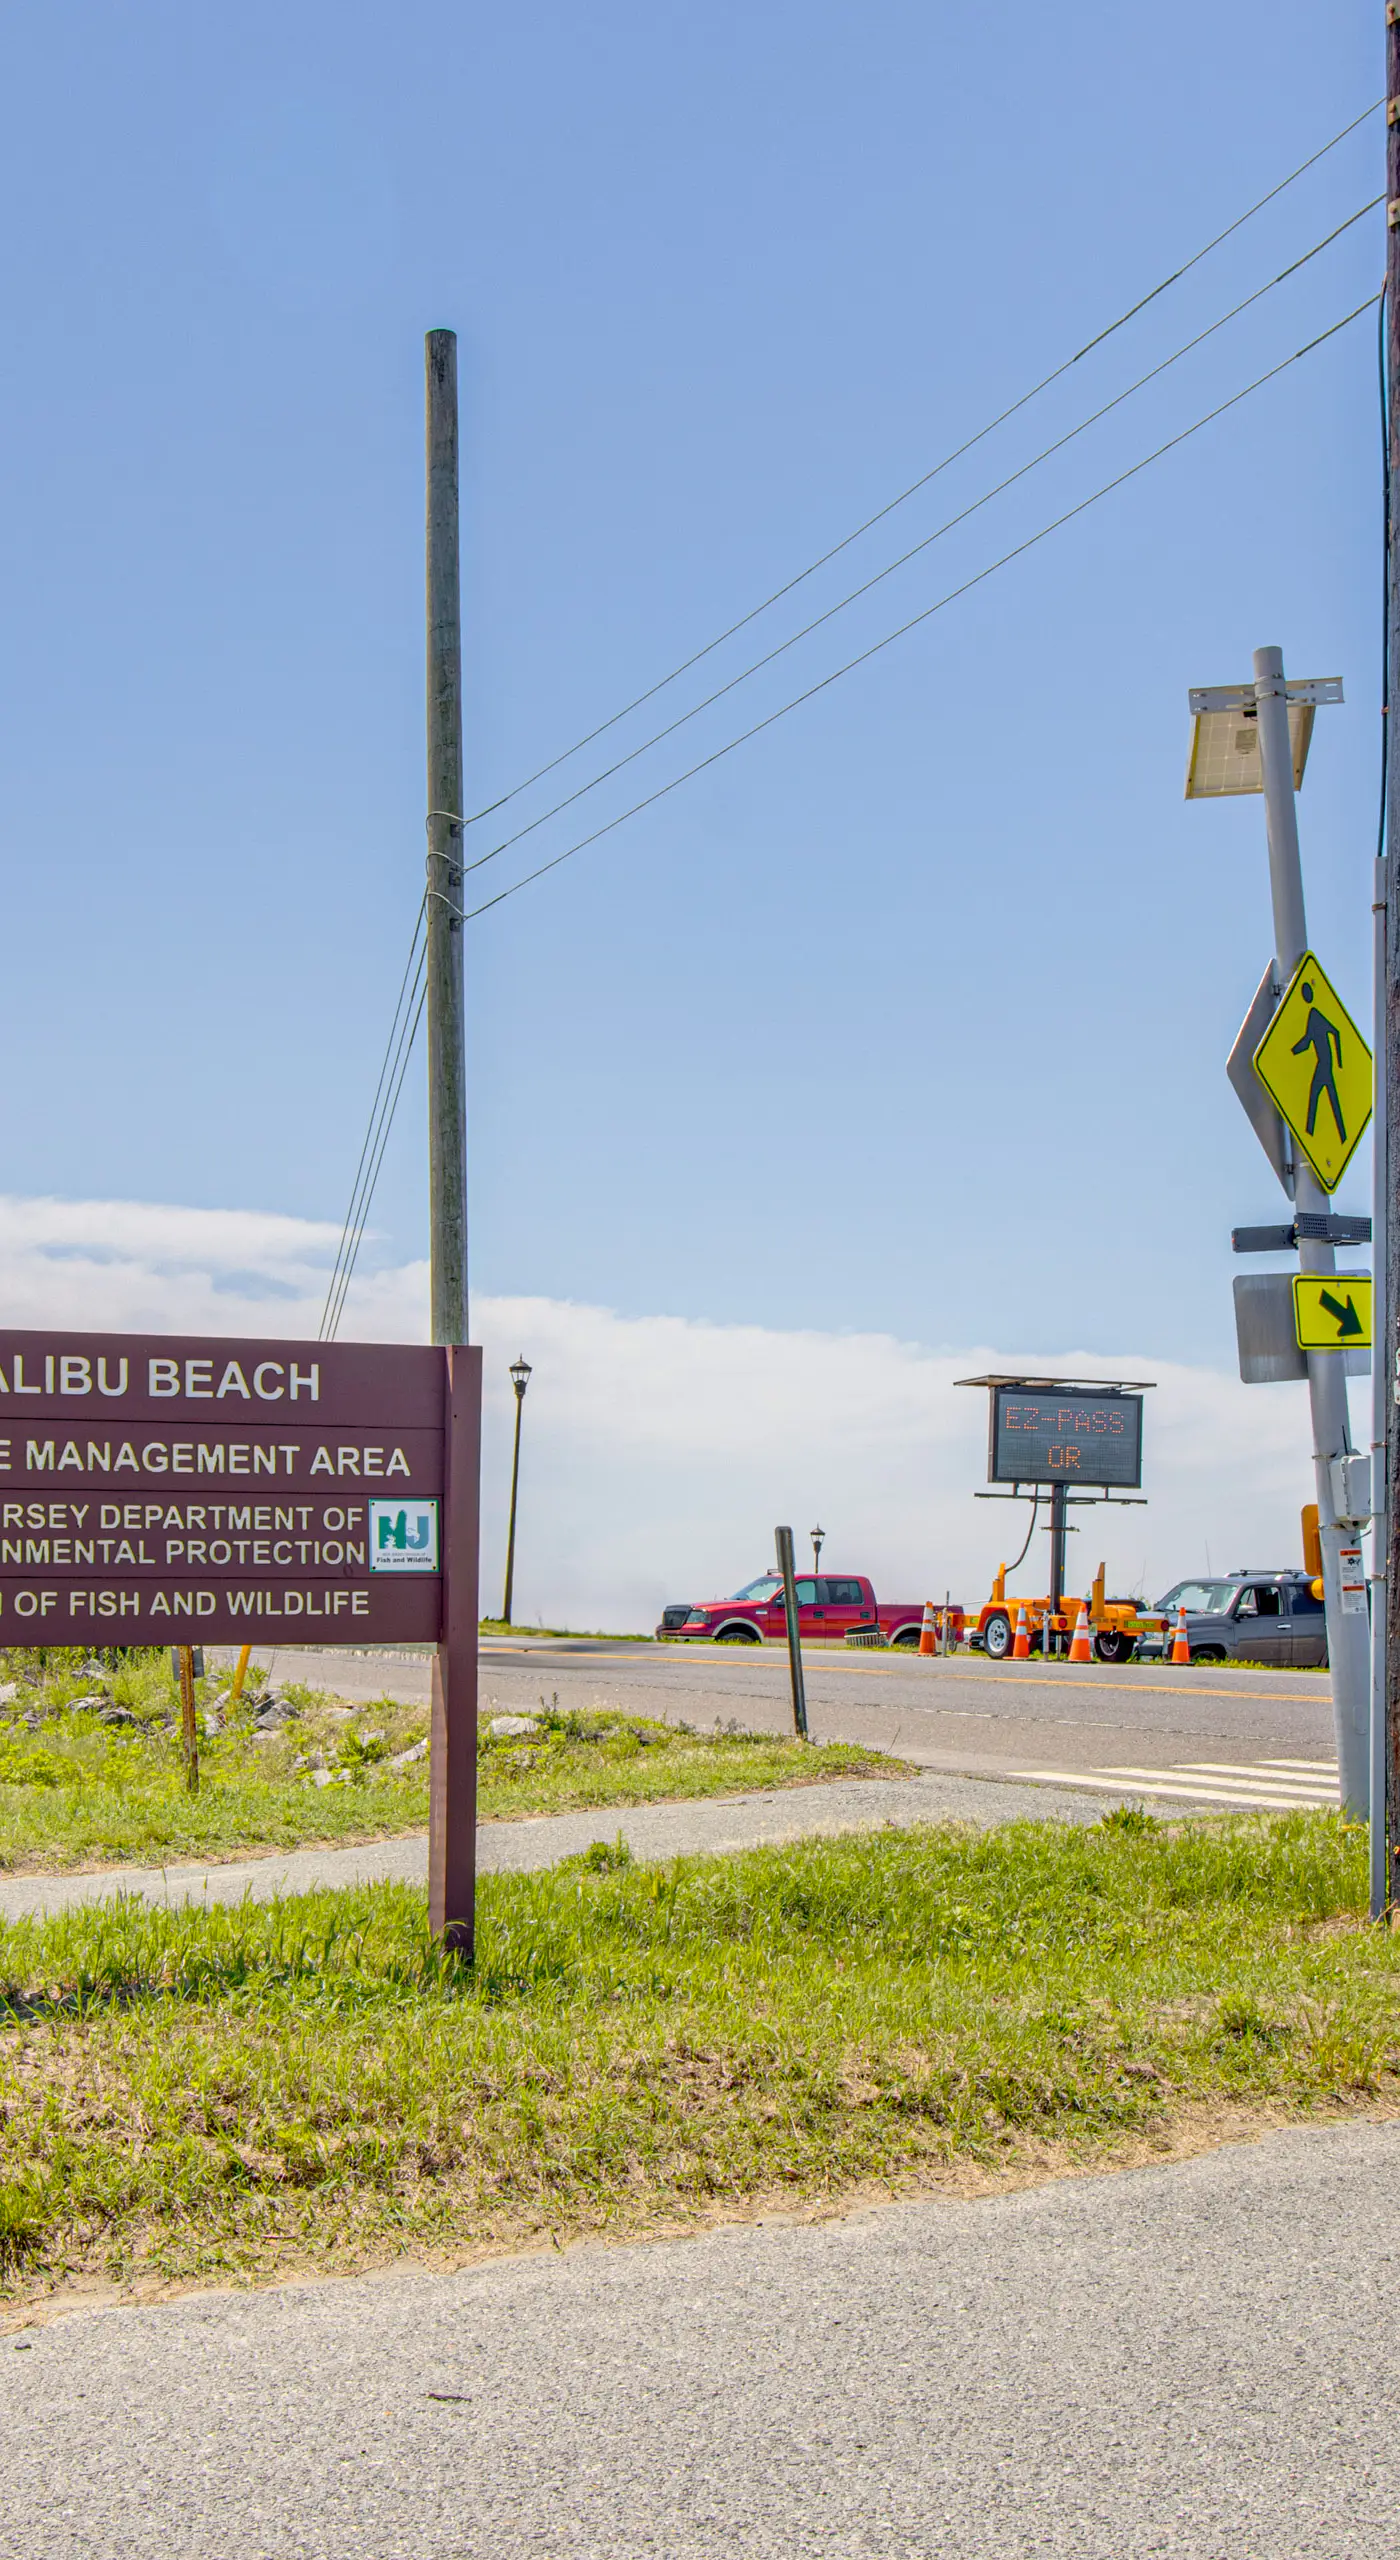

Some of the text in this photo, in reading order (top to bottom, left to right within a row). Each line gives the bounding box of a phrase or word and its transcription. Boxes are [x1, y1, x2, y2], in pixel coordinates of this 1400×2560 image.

[0, 1354, 320, 1401] LIBU BEACH
[1006, 1406, 1124, 1433] EZ-PASS
[25, 1440, 301, 1475] MANAGEMENT
[309, 1446, 411, 1477] AREA
[1048, 1445, 1081, 1469] OR
[3, 1503, 364, 1531] RSEY DEPARTMENT OF
[378, 1509, 430, 1549] NJ
[2, 1539, 365, 1565] NMENTAL PROTECTION
[14, 1591, 58, 1617] OF
[69, 1591, 140, 1617] FISH
[149, 1591, 216, 1617] AND
[226, 1591, 370, 1617] WILDLIFE
